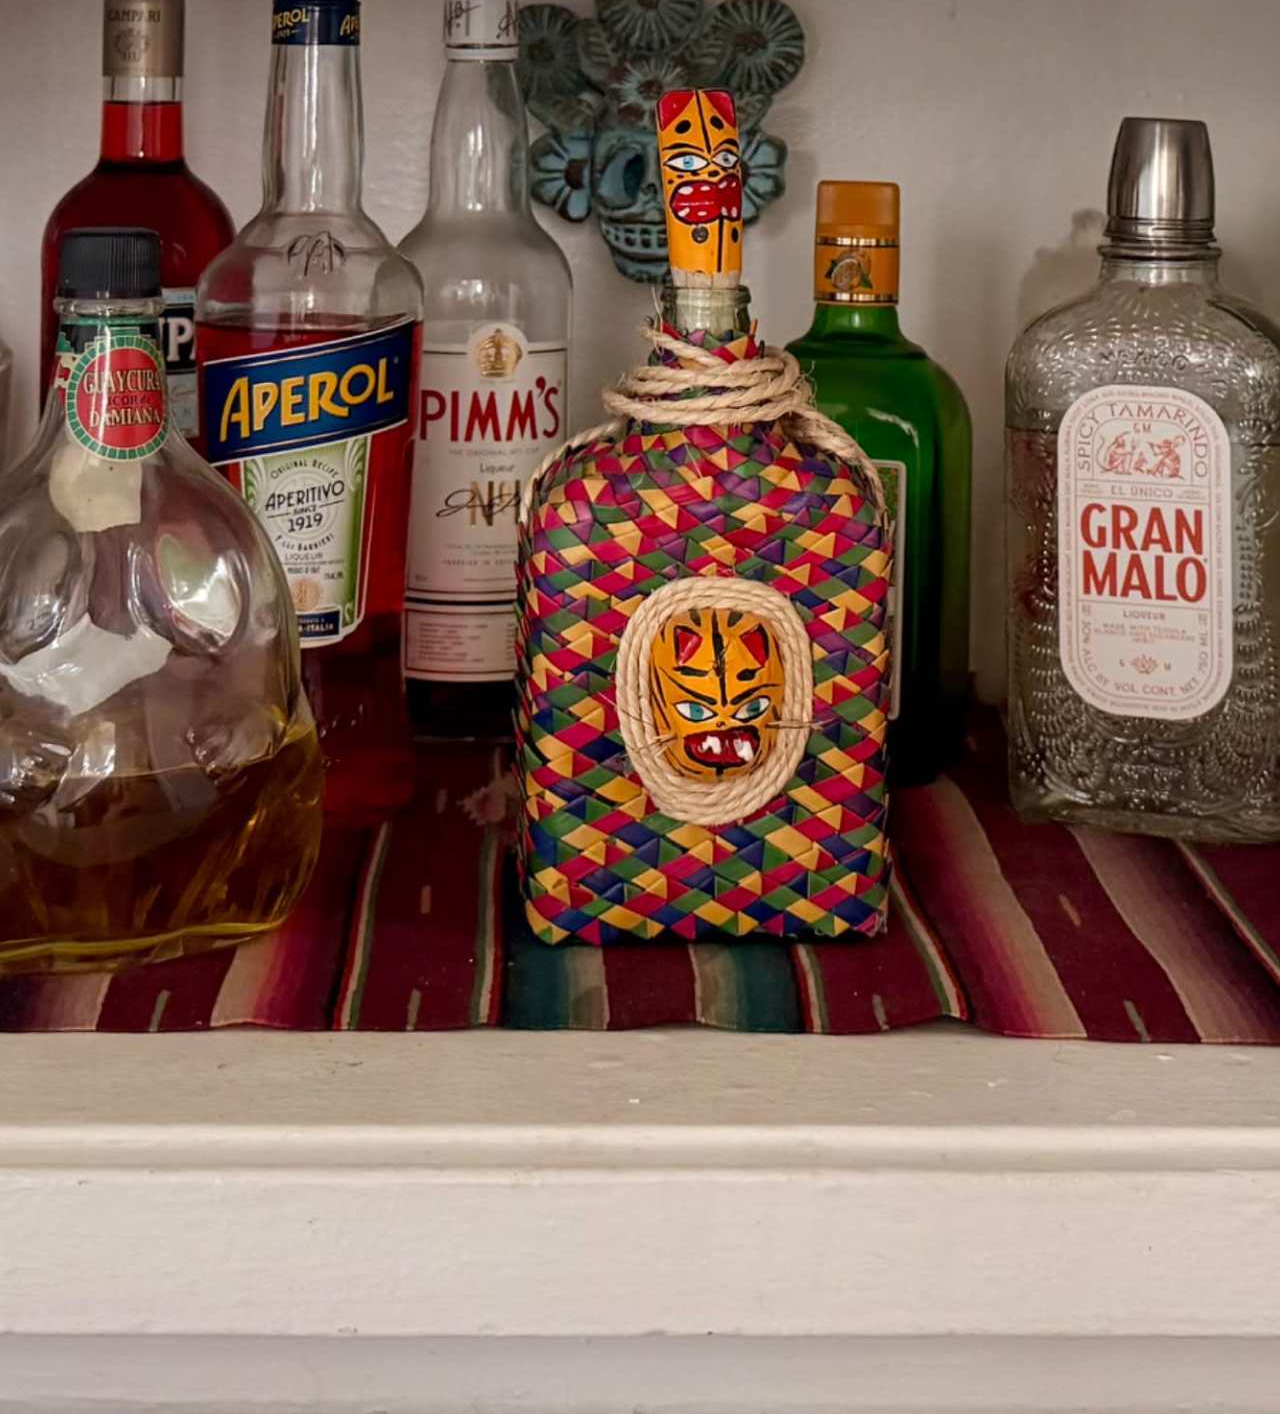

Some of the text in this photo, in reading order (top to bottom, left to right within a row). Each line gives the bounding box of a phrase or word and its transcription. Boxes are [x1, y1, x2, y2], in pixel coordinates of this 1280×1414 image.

[220, 357, 394, 442] APEROL
[420, 376, 560, 442] PIMM'S
[89, 407, 160, 427] DAMIANA
[1078, 402, 1208, 478] SPICY TAMARINDO
[271, 459, 339, 480] ORIGINAL RECIPE
[480, 463, 515, 474] Liqueur
[265, 480, 345, 511] APERITIVO
[1111, 486, 1124, 496] EL
[287, 513, 323, 533] 1919
[293, 506, 317, 516] SINCE
[1081, 503, 1203, 555] GRAN
[1083, 550, 1207, 603] MALO
